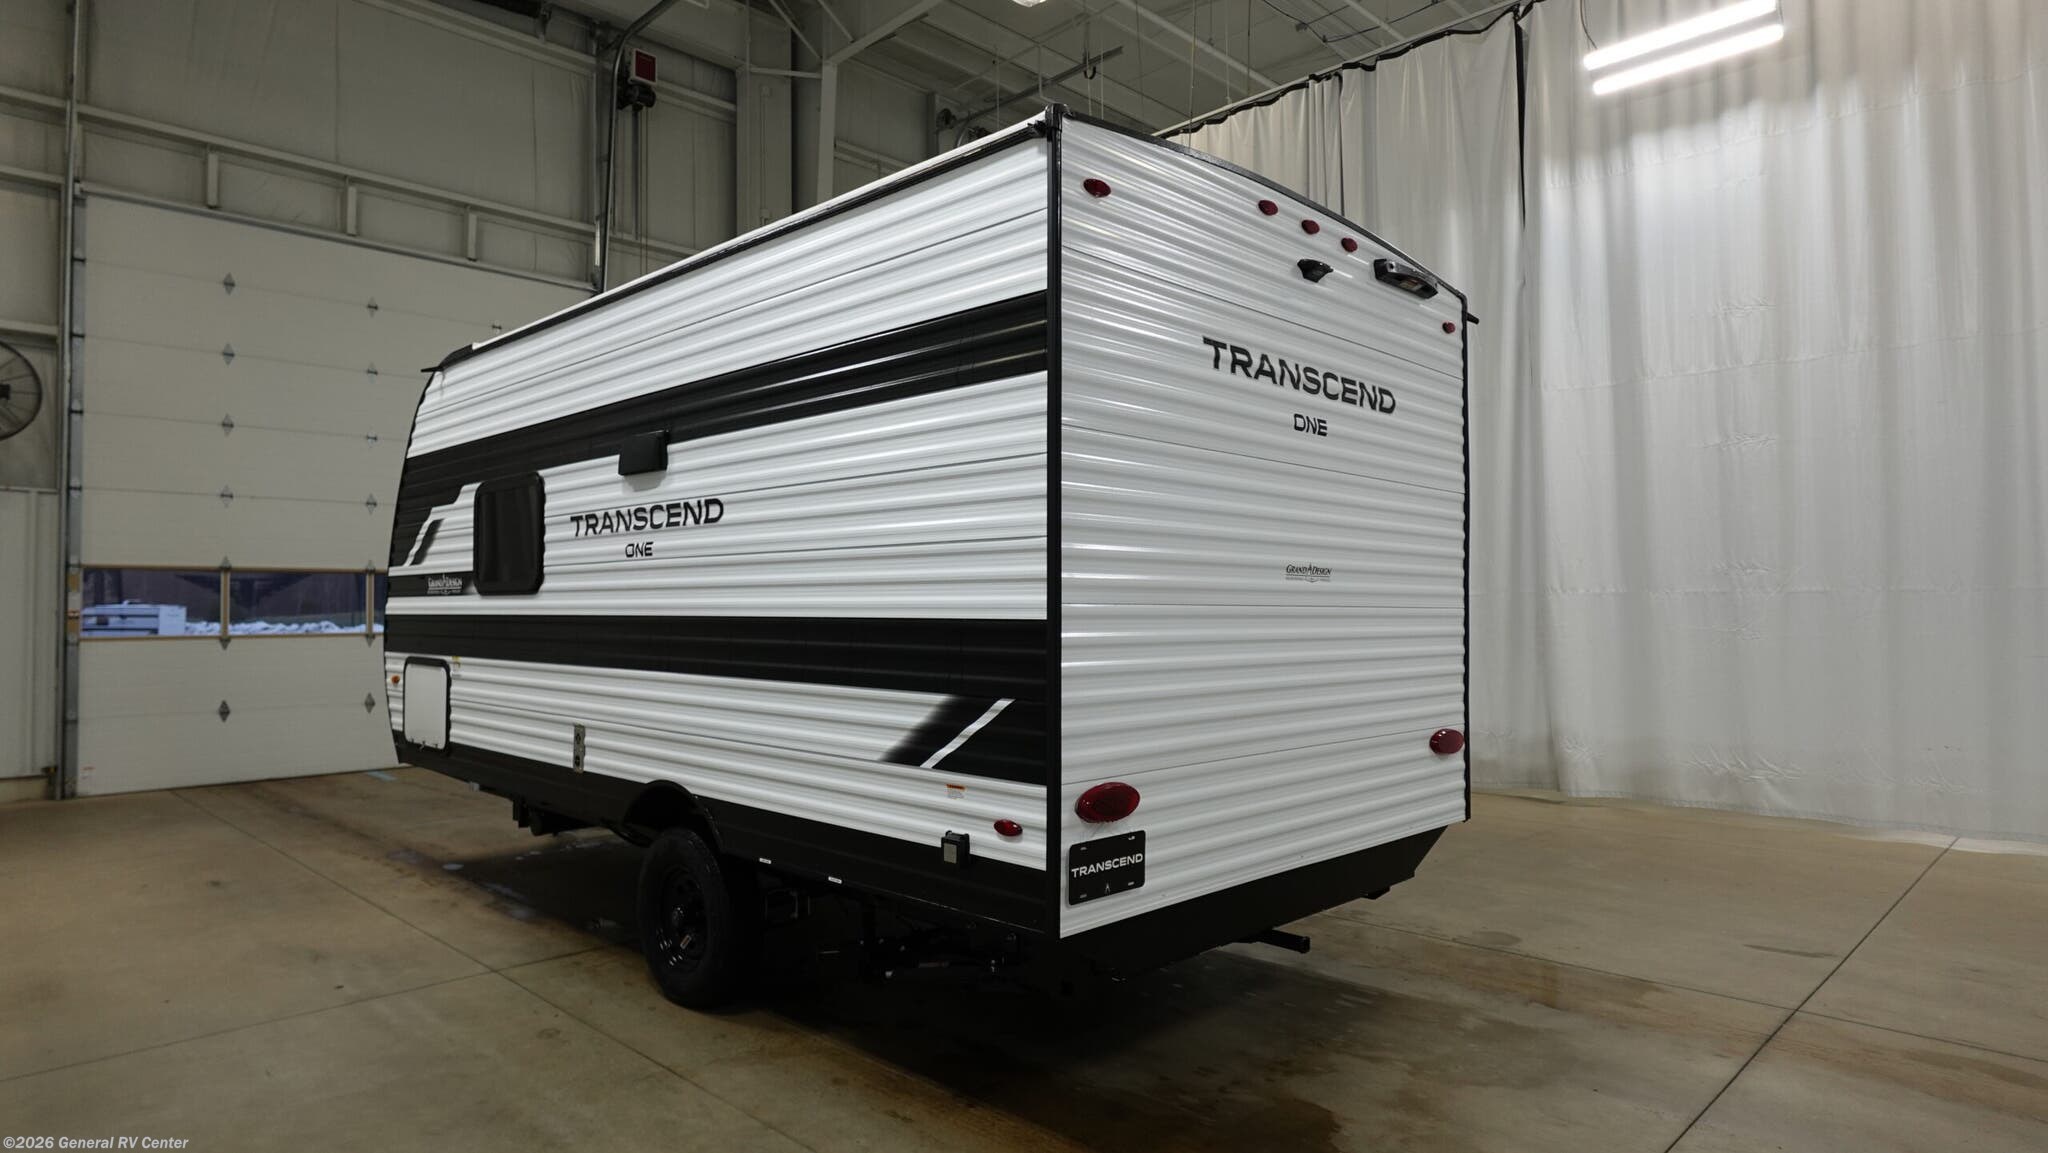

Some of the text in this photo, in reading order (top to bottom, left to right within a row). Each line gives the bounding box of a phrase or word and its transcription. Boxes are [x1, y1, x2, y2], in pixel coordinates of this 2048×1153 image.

[1203, 336, 1396, 414] TRANSCEND
[1294, 413, 1328, 436] ONE
[570, 498, 724, 537] TRANSCEND
[625, 542, 653, 558] ONE
[1071, 853, 1143, 878] TRANSCEND
